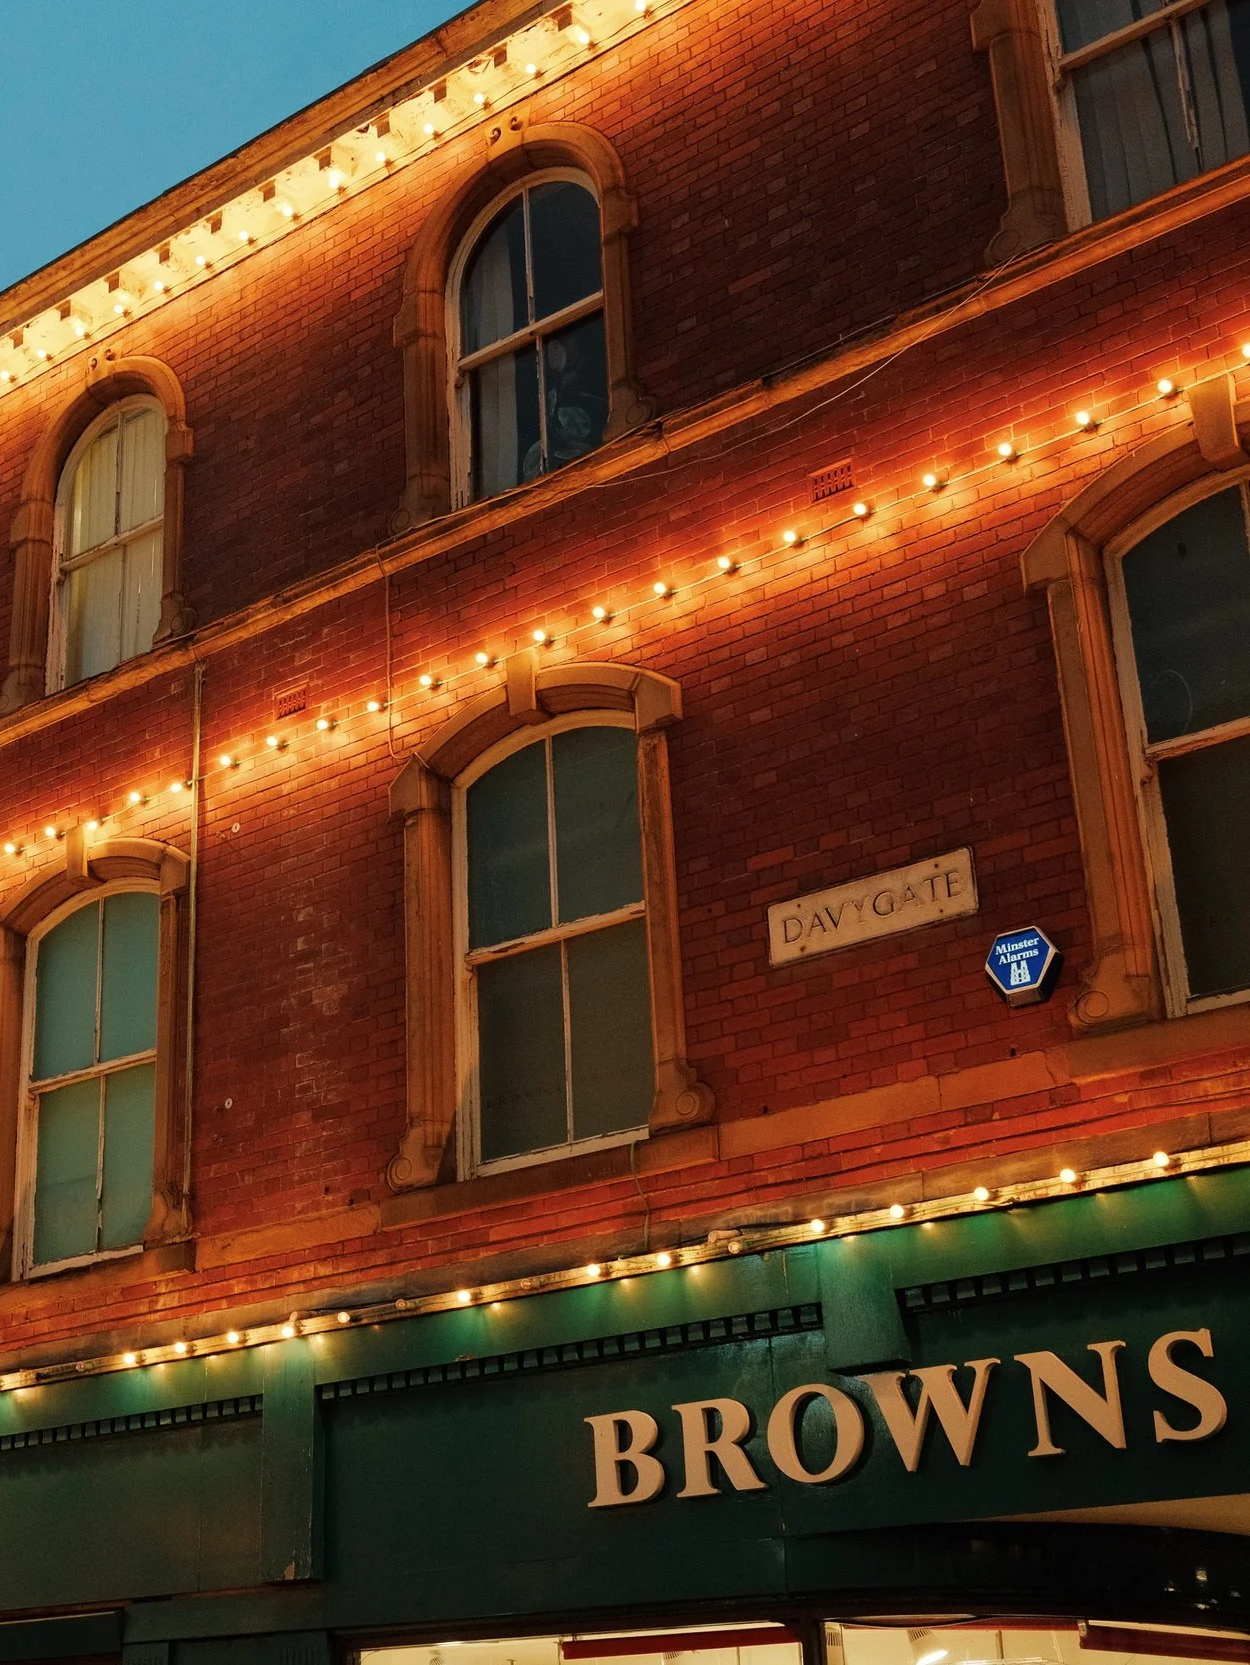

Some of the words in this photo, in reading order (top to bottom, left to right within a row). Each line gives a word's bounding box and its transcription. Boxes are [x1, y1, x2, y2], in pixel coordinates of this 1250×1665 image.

[781, 869, 963, 945] DAVYGATE
[995, 937, 1040, 956] Minster
[998, 948, 1039, 965] Alarms
[583, 1327, 1228, 1508] BROWNS
